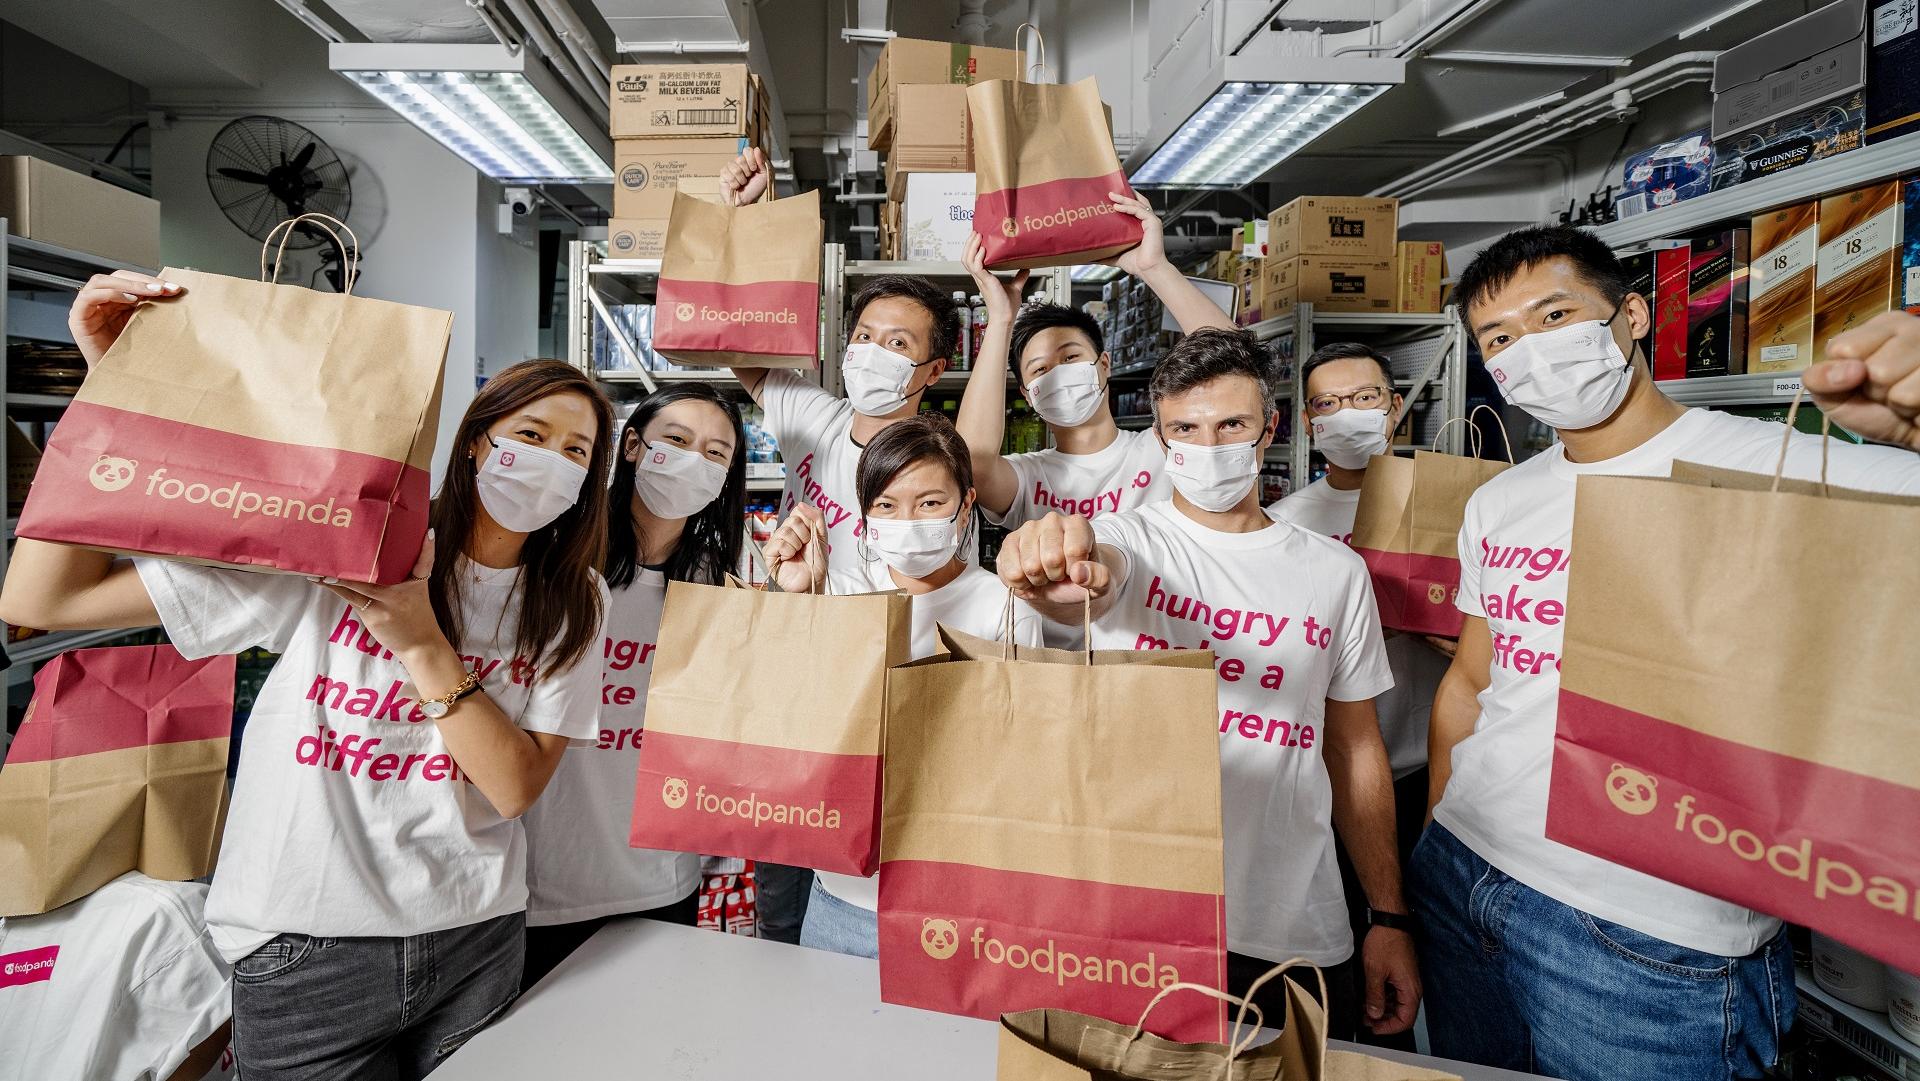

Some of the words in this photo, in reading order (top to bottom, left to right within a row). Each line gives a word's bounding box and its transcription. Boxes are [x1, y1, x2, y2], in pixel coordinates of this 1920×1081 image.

[620, 82, 644, 91] Pauls
[659, 87, 679, 95] MILK
[680, 86, 721, 95] BEVERAGE
[1759, 144, 1810, 167] GUINNESS
[1846, 238, 1862, 255] 18
[1774, 255, 1788, 270] 18
[700, 305, 797, 327] foodpanda
[145, 467, 354, 528] foodpanda
[1145, 575, 1290, 647] hungry
[1303, 616, 1332, 650] to
[1480, 585, 1564, 626] ake
[1259, 664, 1285, 690] a
[695, 785, 841, 829] foodpanda
[970, 927, 1180, 990] foodpanda
